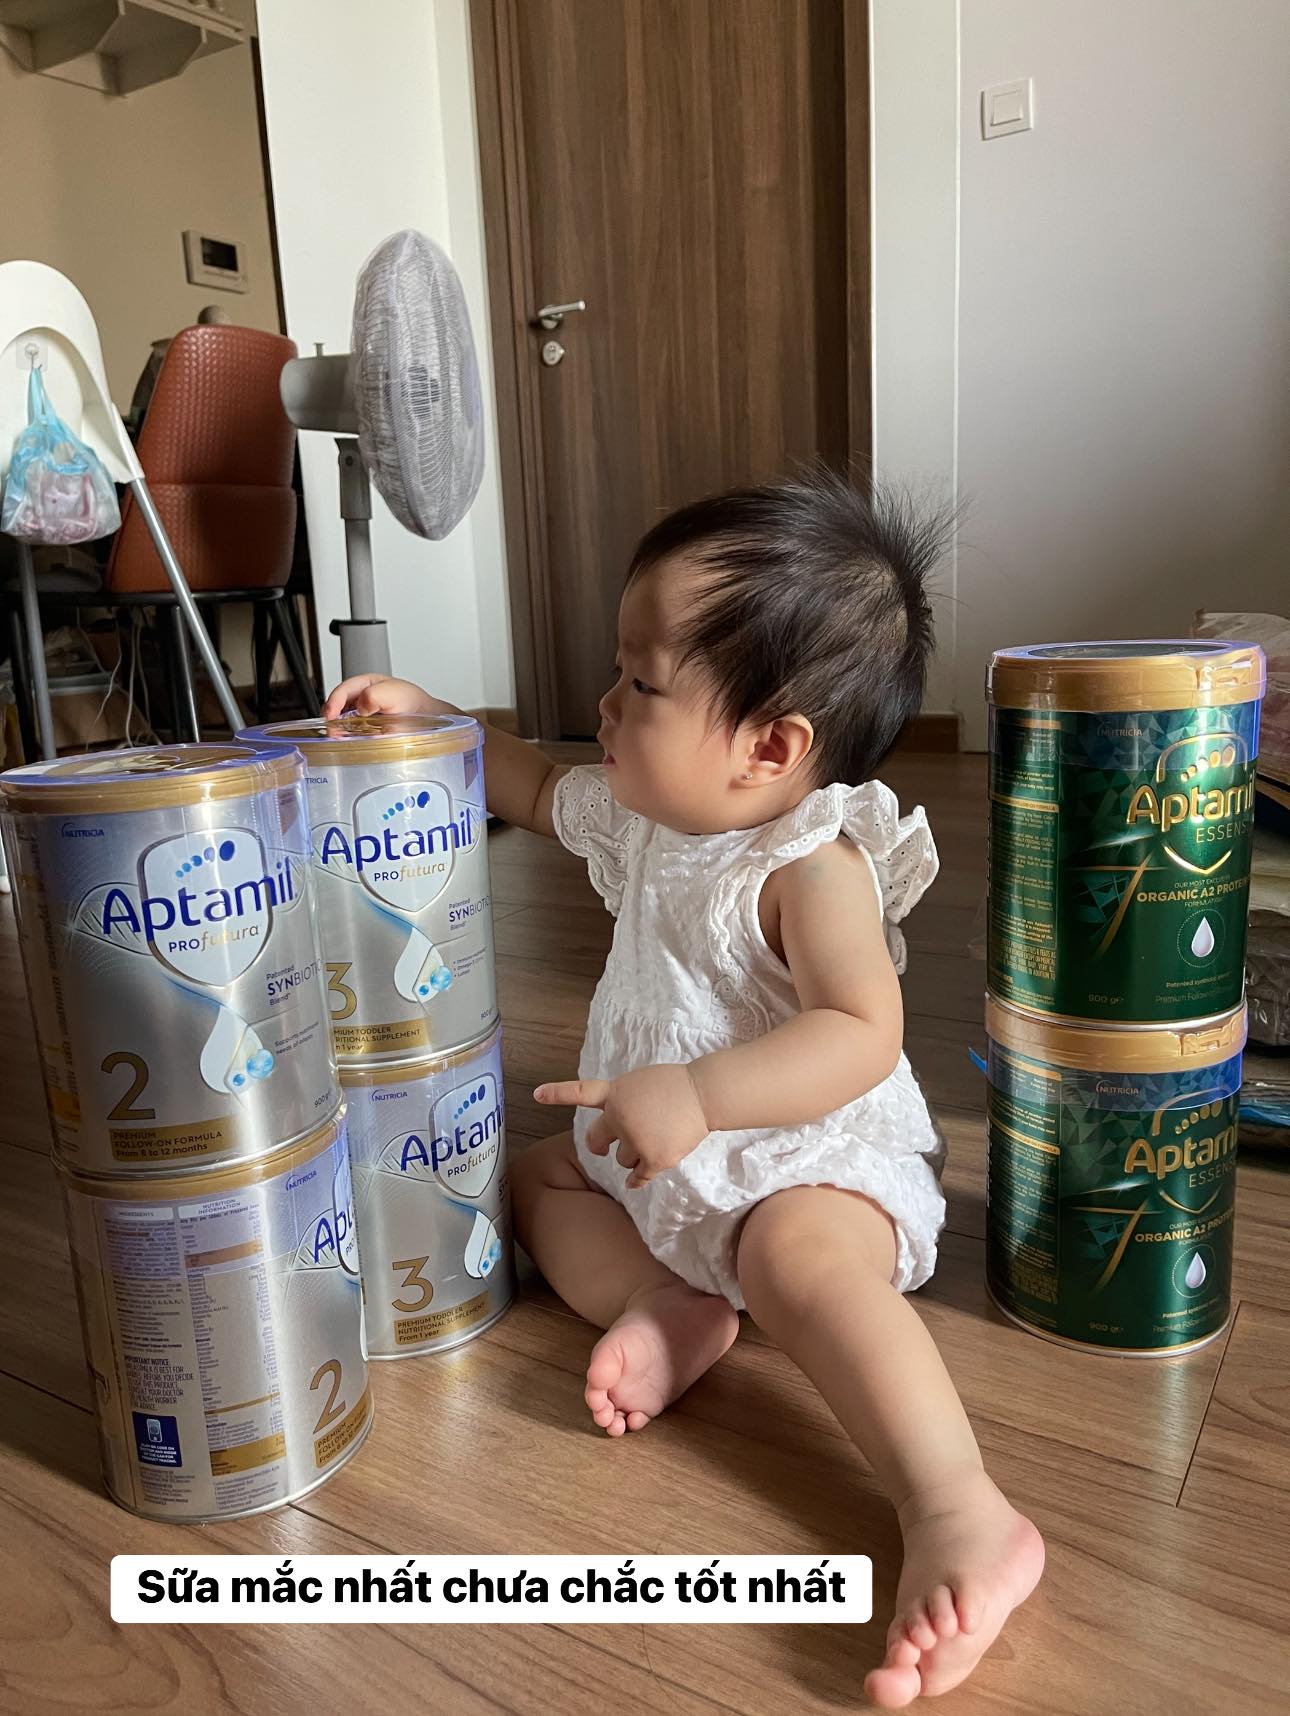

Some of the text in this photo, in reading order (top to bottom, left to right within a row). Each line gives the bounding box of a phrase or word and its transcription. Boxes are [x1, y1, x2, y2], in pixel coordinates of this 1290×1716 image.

[64, 826, 105, 838] NUTRICIA
[322, 807, 473, 872] Aptamil
[374, 862, 446, 882] PROfutura
[1174, 881, 1188, 889] OUR
[103, 856, 297, 942] Aptamil
[1136, 889, 1199, 903] ORGANIC
[1200, 886, 1215, 898] A2
[169, 924, 259, 953] PROfutura
[266, 964, 295, 980] Patented
[326, 962, 357, 1020] 3
[356, 1027, 391, 1035] TODDLER
[371, 1029, 420, 1041] SUPPLEMENT
[101, 1052, 156, 1120] 2
[1100, 1086, 1139, 1095] NUTRICIA
[374, 1091, 408, 1101] NUTRICIA
[112, 1131, 156, 1140] PREMIUM
[114, 1131, 222, 1149] FOLLOW-ON FORMULA
[116, 1149, 139, 1157] From
[149, 1148, 159, 1157] to
[161, 1147, 171, 1155] 12
[173, 1143, 208, 1154] months
[447, 1144, 496, 1178] PROfutura
[287, 1169, 317, 1190] NUTRICIA
[198, 1202, 241, 1214] INFORMATION
[203, 1199, 236, 1209] NUTRITION
[1135, 1228, 1192, 1243] ORGANIC
[1193, 1224, 1206, 1236] A2
[391, 1255, 434, 1312] 3
[397, 1306, 463, 1328] PREMIUM TODDLER
[398, 1320, 446, 1335] NUTRITIONAL
[399, 1334, 418, 1342] From
[425, 1330, 440, 1338] year
[309, 1359, 346, 1434] 2
